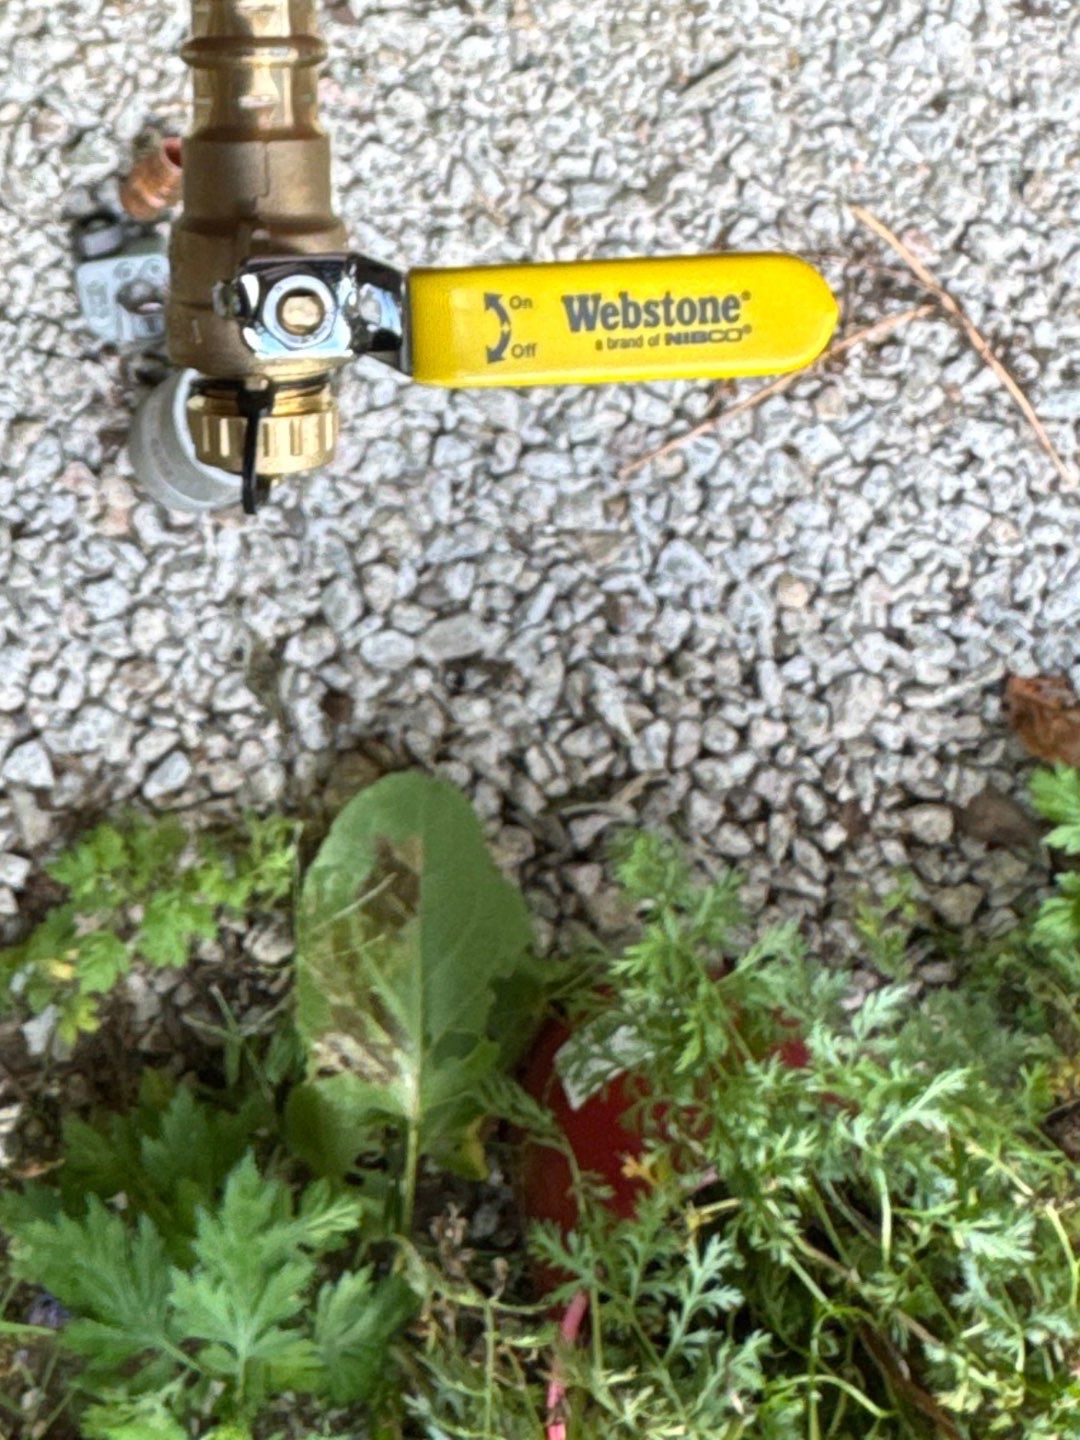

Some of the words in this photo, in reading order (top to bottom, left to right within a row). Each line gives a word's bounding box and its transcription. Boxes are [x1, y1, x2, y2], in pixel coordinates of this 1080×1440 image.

[509, 295, 533, 310] On
[595, 339, 604, 351] a
[607, 333, 644, 349] brand
[647, 331, 662, 347] of
[510, 342, 536, 359] Off
